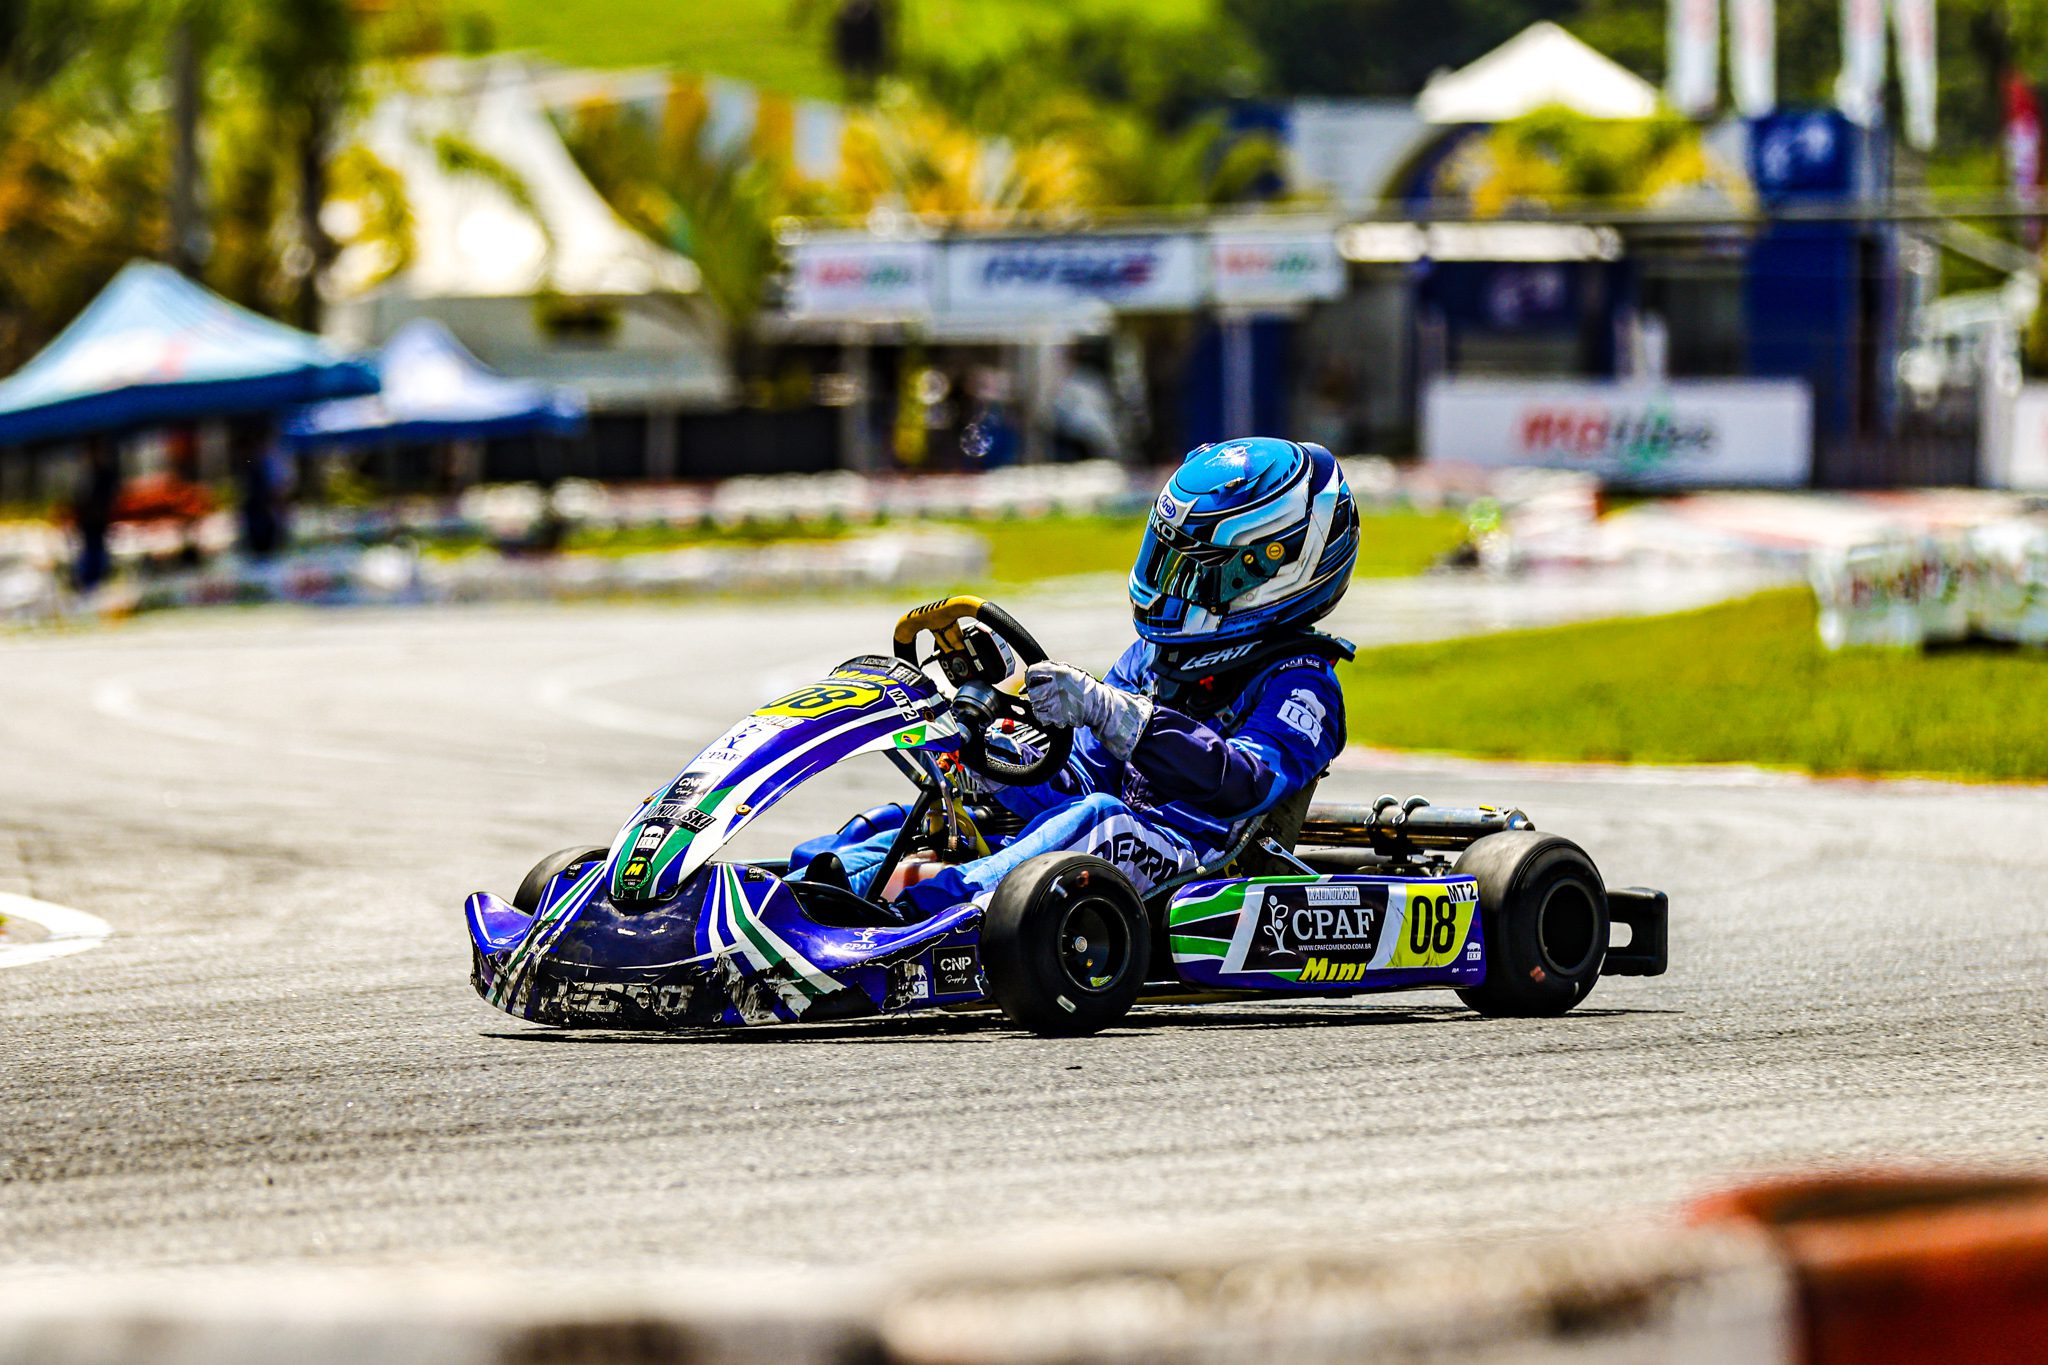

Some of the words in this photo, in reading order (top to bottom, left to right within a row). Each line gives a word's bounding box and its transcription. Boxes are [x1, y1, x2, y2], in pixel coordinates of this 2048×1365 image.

[1161, 497, 1175, 516] Arai
[1181, 641, 1263, 671] LEATT
[758, 687, 858, 710] 08
[889, 689, 918, 720] MT2
[624, 863, 645, 876] M
[1448, 882, 1477, 903] MT2
[1292, 909, 1375, 940] CPAF
[1410, 896, 1456, 954] 08
[1298, 943, 1372, 951] WWW.CPAFCOMERCIO.COM.BR
[940, 956, 972, 971] CNP
[1298, 957, 1367, 981] Mini
[945, 974, 968, 984] Supply
